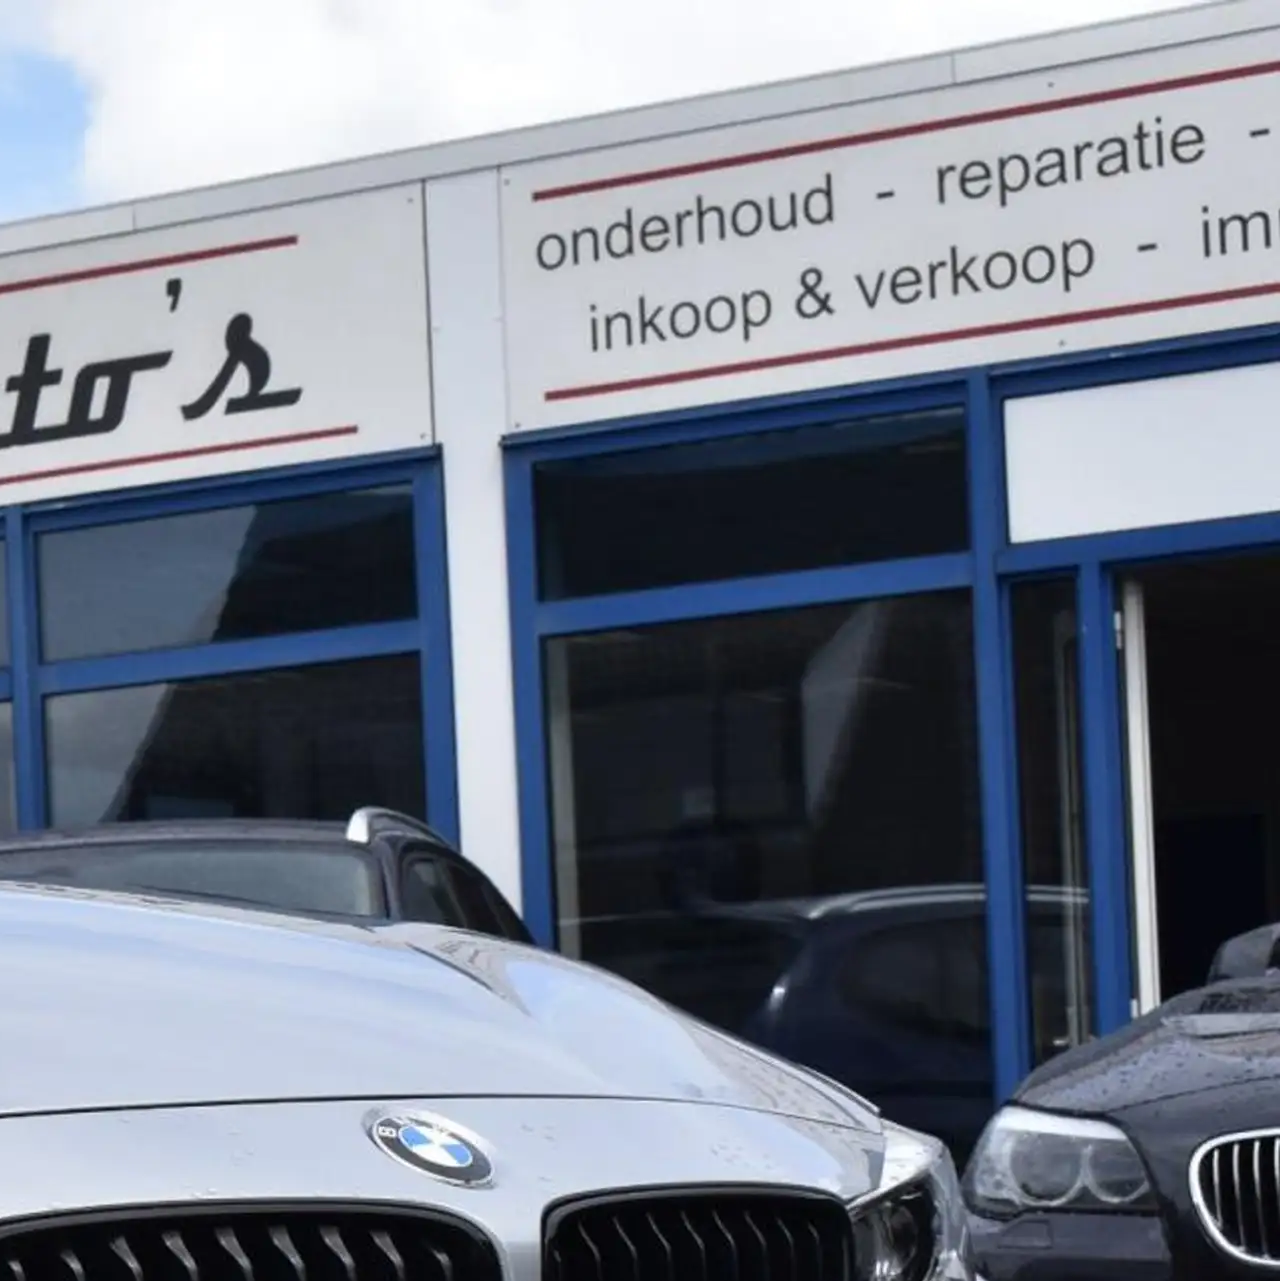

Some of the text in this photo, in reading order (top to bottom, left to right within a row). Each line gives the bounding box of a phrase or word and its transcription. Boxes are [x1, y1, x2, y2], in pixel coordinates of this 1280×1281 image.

[536, 172, 835, 271] onderhoud
[936, 115, 1206, 208] reparatie
[588, 288, 773, 353] inkoop
[794, 266, 836, 320] &
[854, 236, 1096, 309] verkoop
[1200, 204, 1280, 258] im
